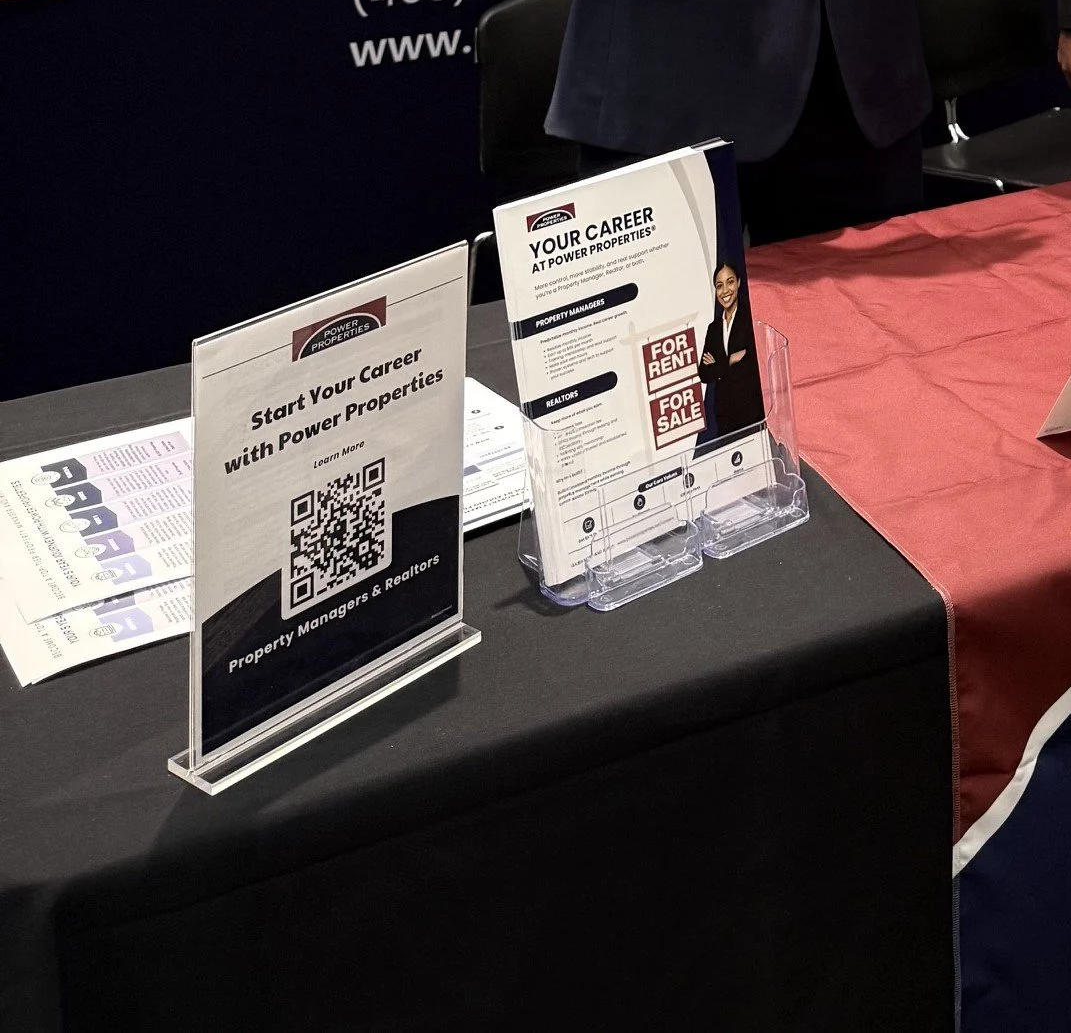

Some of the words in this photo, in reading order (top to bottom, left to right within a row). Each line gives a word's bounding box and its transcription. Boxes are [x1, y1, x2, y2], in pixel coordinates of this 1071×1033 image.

[349, 27, 478, 67] www.
[536, 216, 568, 228] PROPERTIES
[542, 213, 561, 222] POWER
[529, 229, 581, 259] YOUR
[585, 207, 654, 241] CAREER
[532, 260, 547, 274] AT
[549, 248, 588, 268] POWER
[534, 281, 548, 291] More
[549, 275, 569, 287] control,
[569, 270, 584, 280] more
[584, 264, 606, 276] stability,
[628, 249, 649, 261] support
[649, 242, 669, 253] whether
[535, 288, 553, 300] you're
[557, 278, 581, 292] Property
[536, 311, 569, 328] PROPERTY
[569, 298, 605, 316] MANAGERS
[311, 323, 370, 352] PROPERTIES
[323, 319, 358, 338] POWER
[650, 333, 688, 361] FOR
[648, 347, 694, 379] RENT
[251, 393, 306, 430] Start
[309, 375, 356, 405] Your
[359, 348, 422, 384] Career
[546, 390, 579, 408] REALTORS
[659, 388, 695, 415] FOR
[224, 442, 274, 475] with
[279, 413, 341, 451] Power
[345, 369, 444, 421] Properties
[657, 402, 702, 433] SALE
[314, 452, 339, 469] Learn
[342, 440, 365, 457] More
[66, 573, 82, 587] YOUR
[228, 631, 294, 673] Property
[297, 593, 369, 637] Managers
[372, 582, 382, 597] &
[385, 554, 440, 590] Realtors
